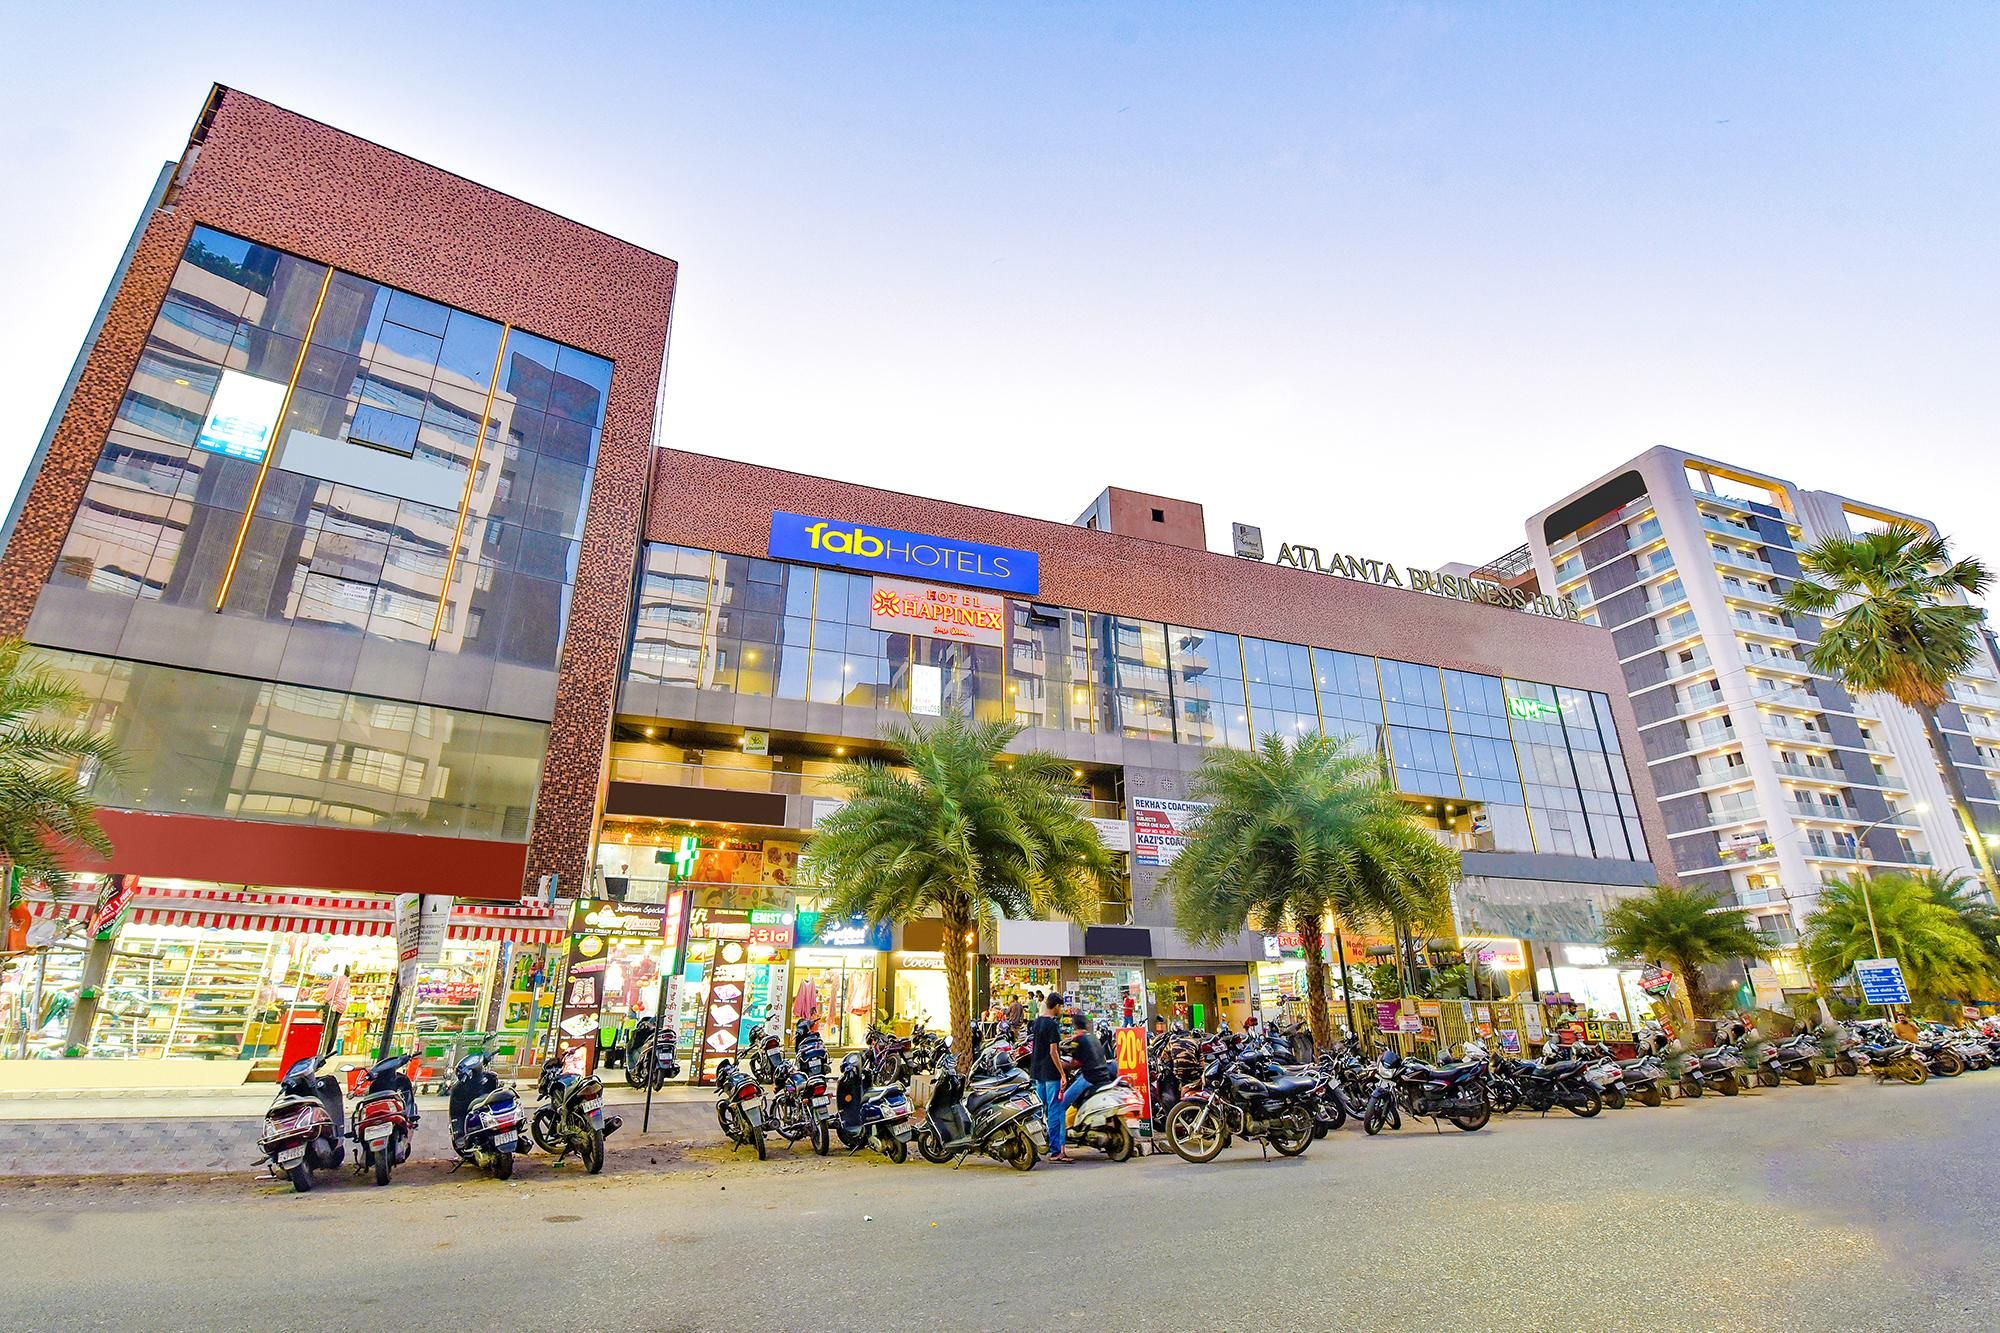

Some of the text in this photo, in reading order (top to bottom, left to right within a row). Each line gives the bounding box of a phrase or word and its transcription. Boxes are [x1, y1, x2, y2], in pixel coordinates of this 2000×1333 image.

[1277, 543, 1581, 620] ATLANTA BUSINESS HUB
[927, 590, 980, 607] HOTEL
[902, 599, 1003, 630] HAPPINEX
[1135, 800, 1167, 810] REKHA'S
[1137, 835, 1164, 845] KAZI'S
[1019, 958, 1039, 966] SUPER
[1040, 959, 1059, 967] STORE
[1079, 958, 1105, 966] KRISHNA
[1117, 1029, 1146, 1070] 20%
